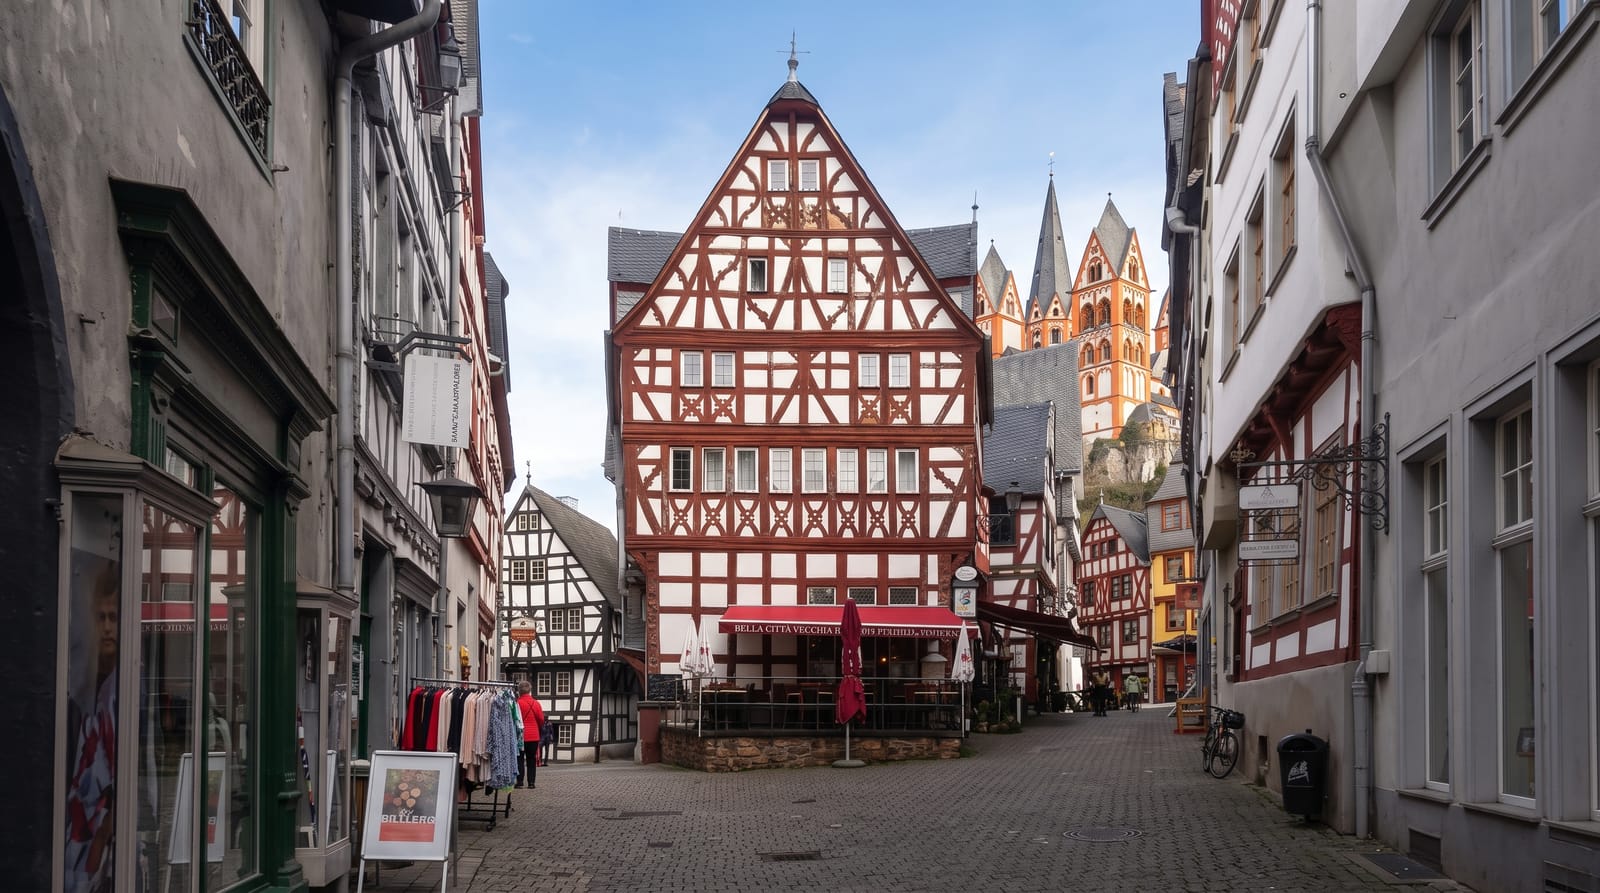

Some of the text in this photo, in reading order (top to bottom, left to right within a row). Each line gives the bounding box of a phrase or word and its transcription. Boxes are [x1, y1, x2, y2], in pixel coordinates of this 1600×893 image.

[734, 623, 764, 633] BELLA
[765, 623, 792, 633] CITTÀ
[793, 625, 833, 635] VECCHIA
